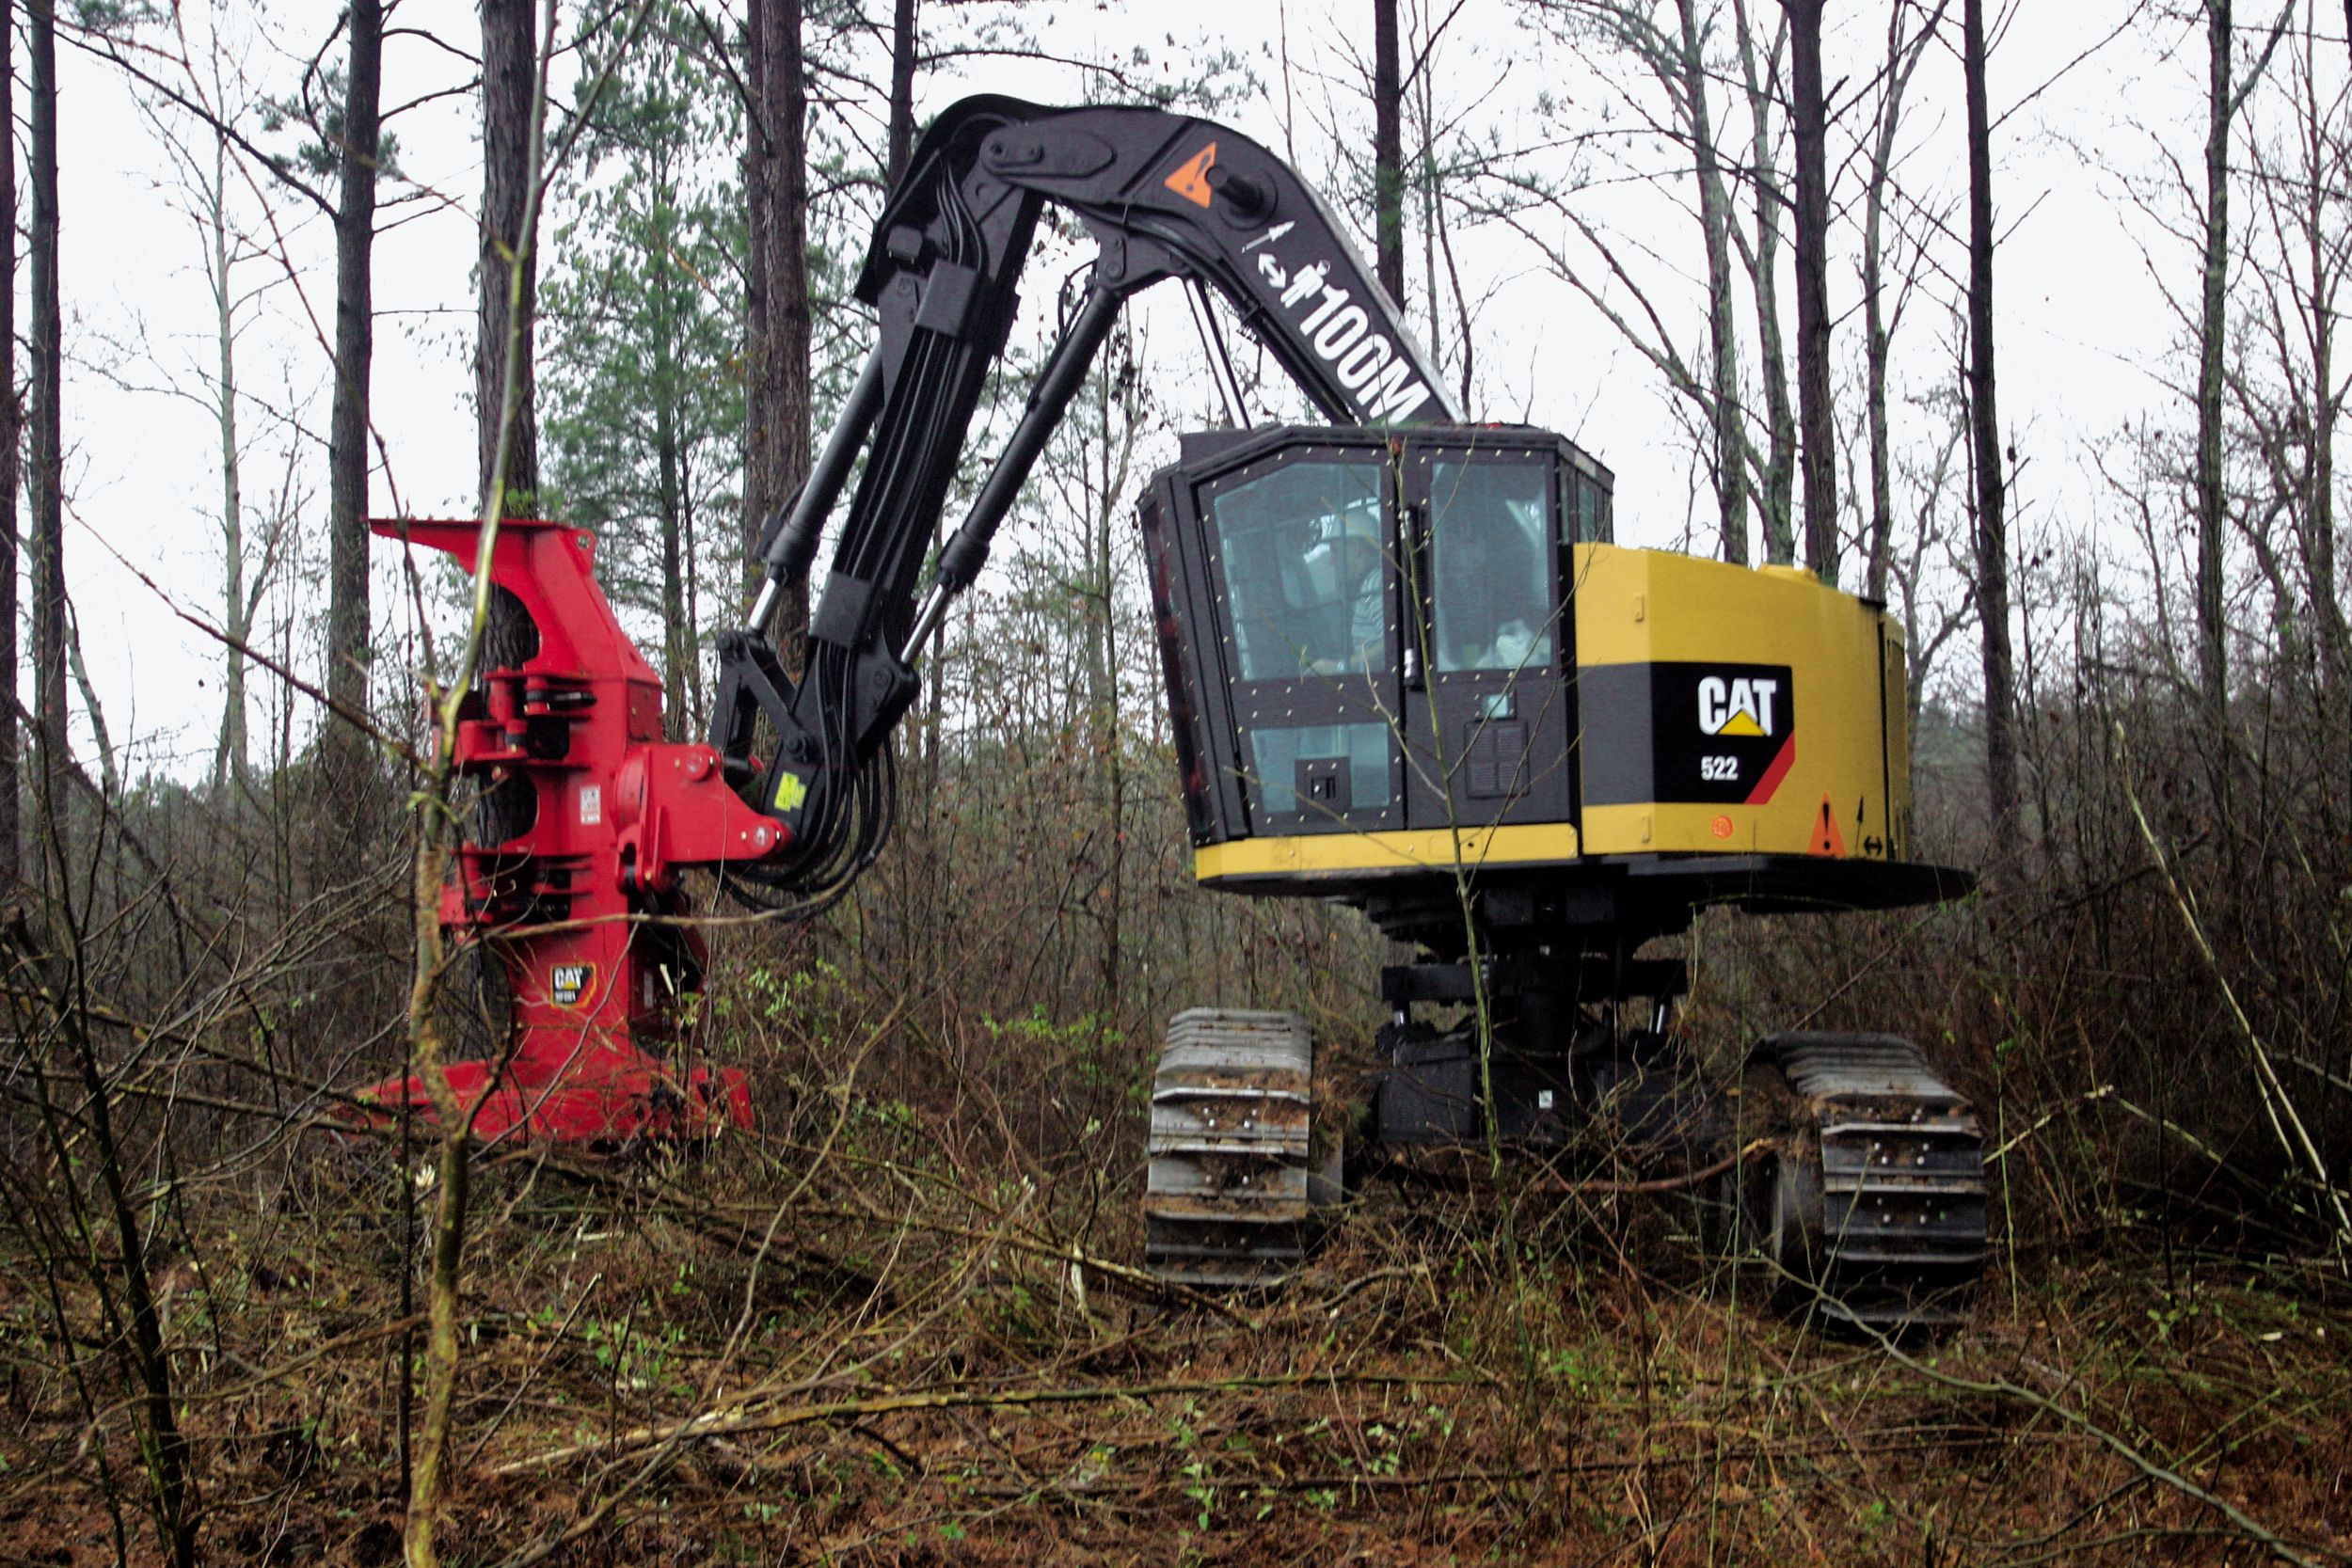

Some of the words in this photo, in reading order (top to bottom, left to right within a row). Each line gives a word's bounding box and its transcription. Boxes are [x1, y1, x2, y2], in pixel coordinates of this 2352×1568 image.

[1299, 284, 1431, 425] 100M
[1697, 675, 1777, 736] CAT
[1700, 755, 1739, 781] 522
[554, 966, 583, 990] CAT
